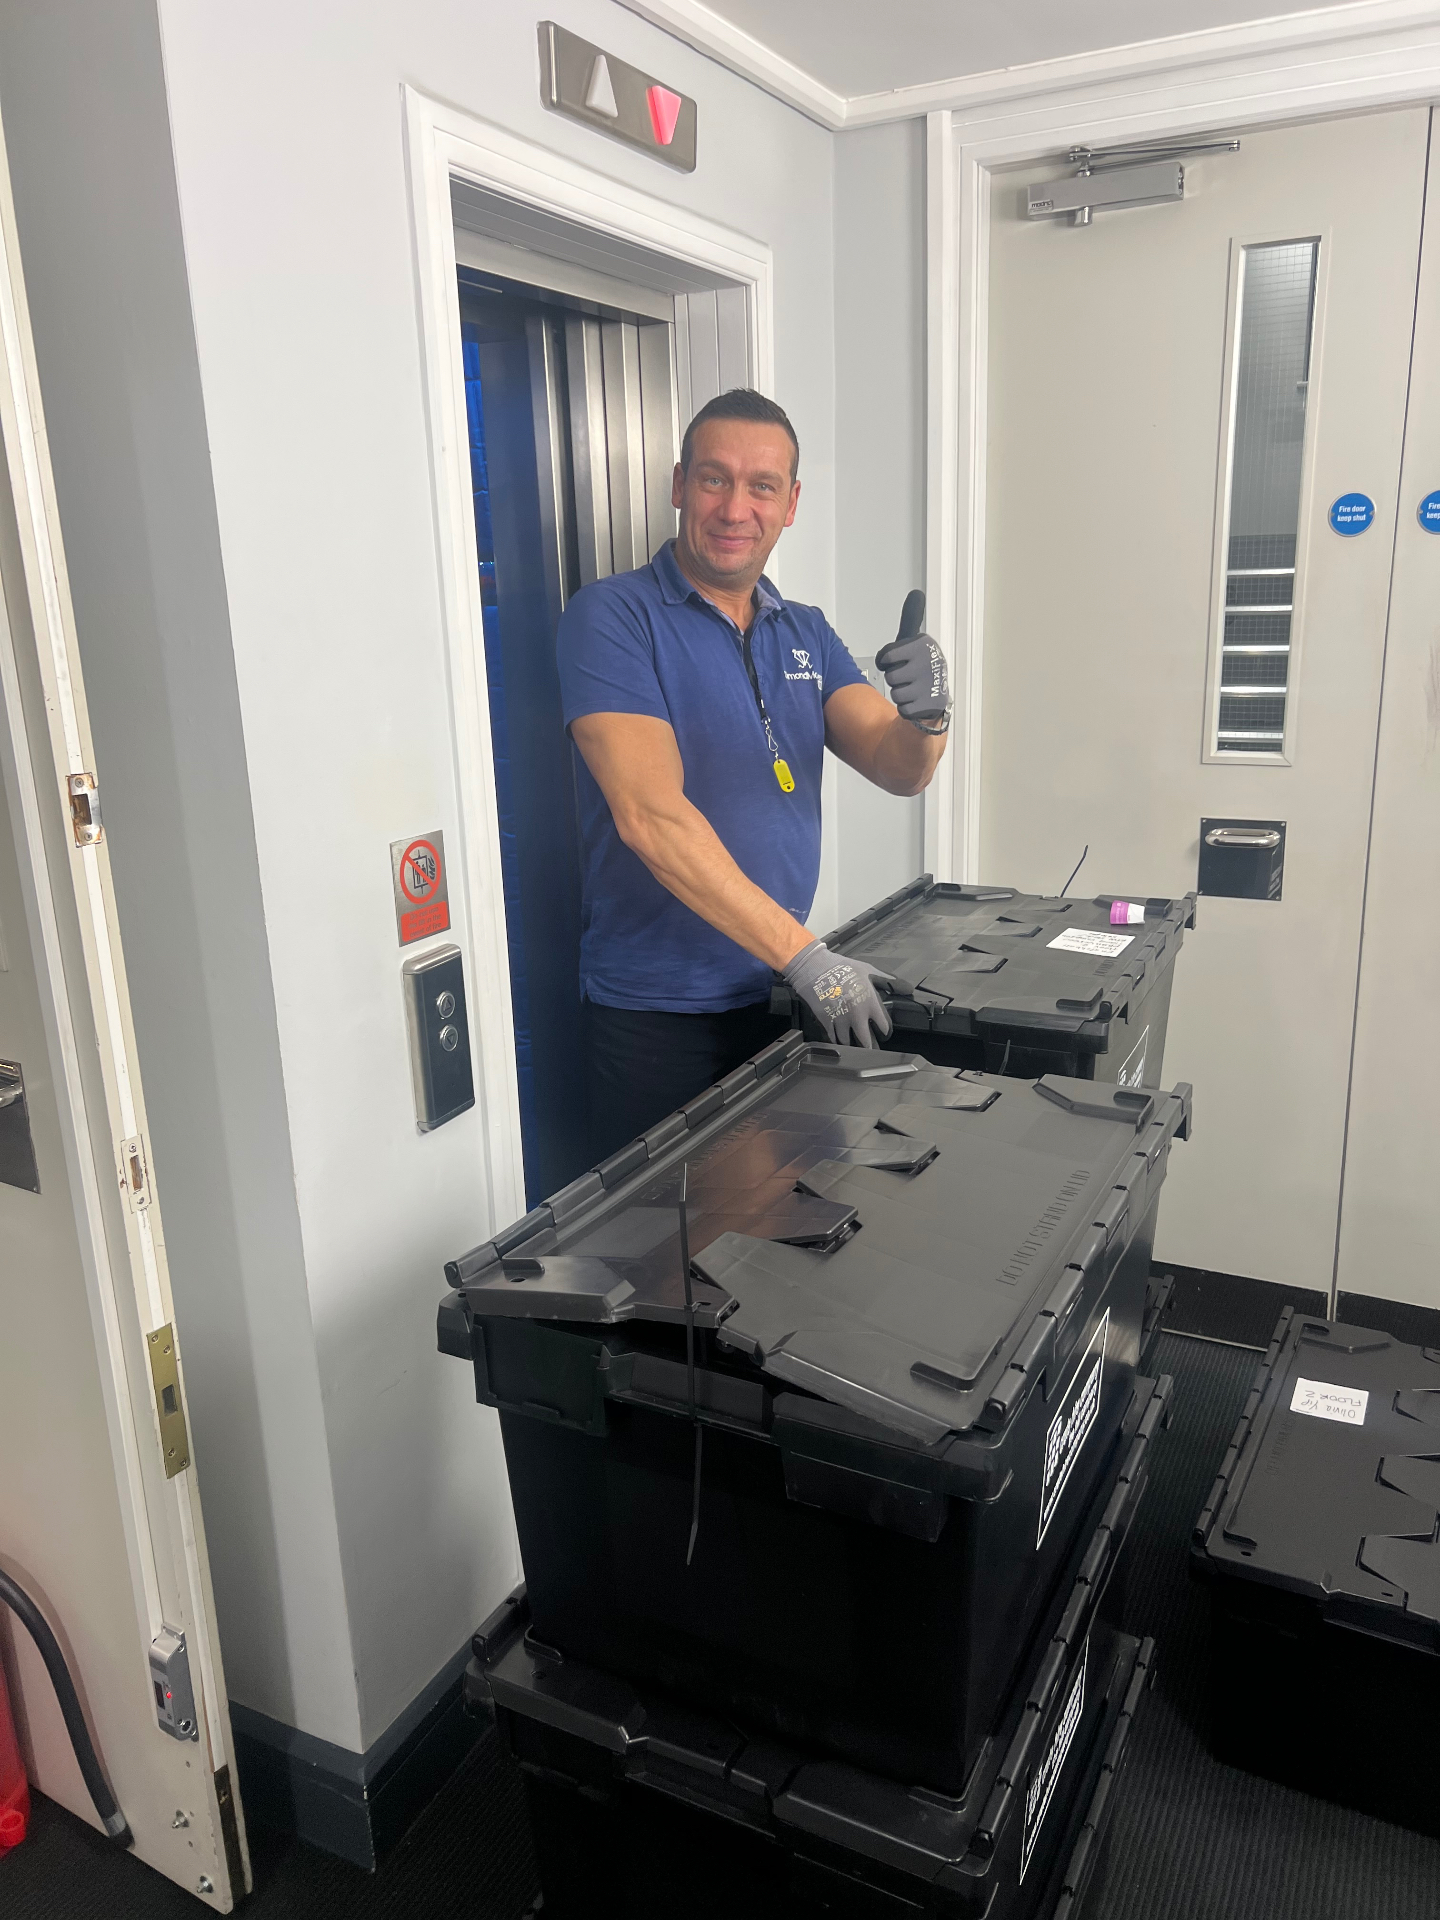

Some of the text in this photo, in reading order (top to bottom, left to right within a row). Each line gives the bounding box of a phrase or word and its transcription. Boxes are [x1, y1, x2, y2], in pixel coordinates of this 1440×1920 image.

[1337, 514, 1352, 522] keep
[930, 644, 941, 698] MaxiFlex
[1320, 1394, 1361, 1406] FLOOR
[1326, 1404, 1356, 1418] Olivia
